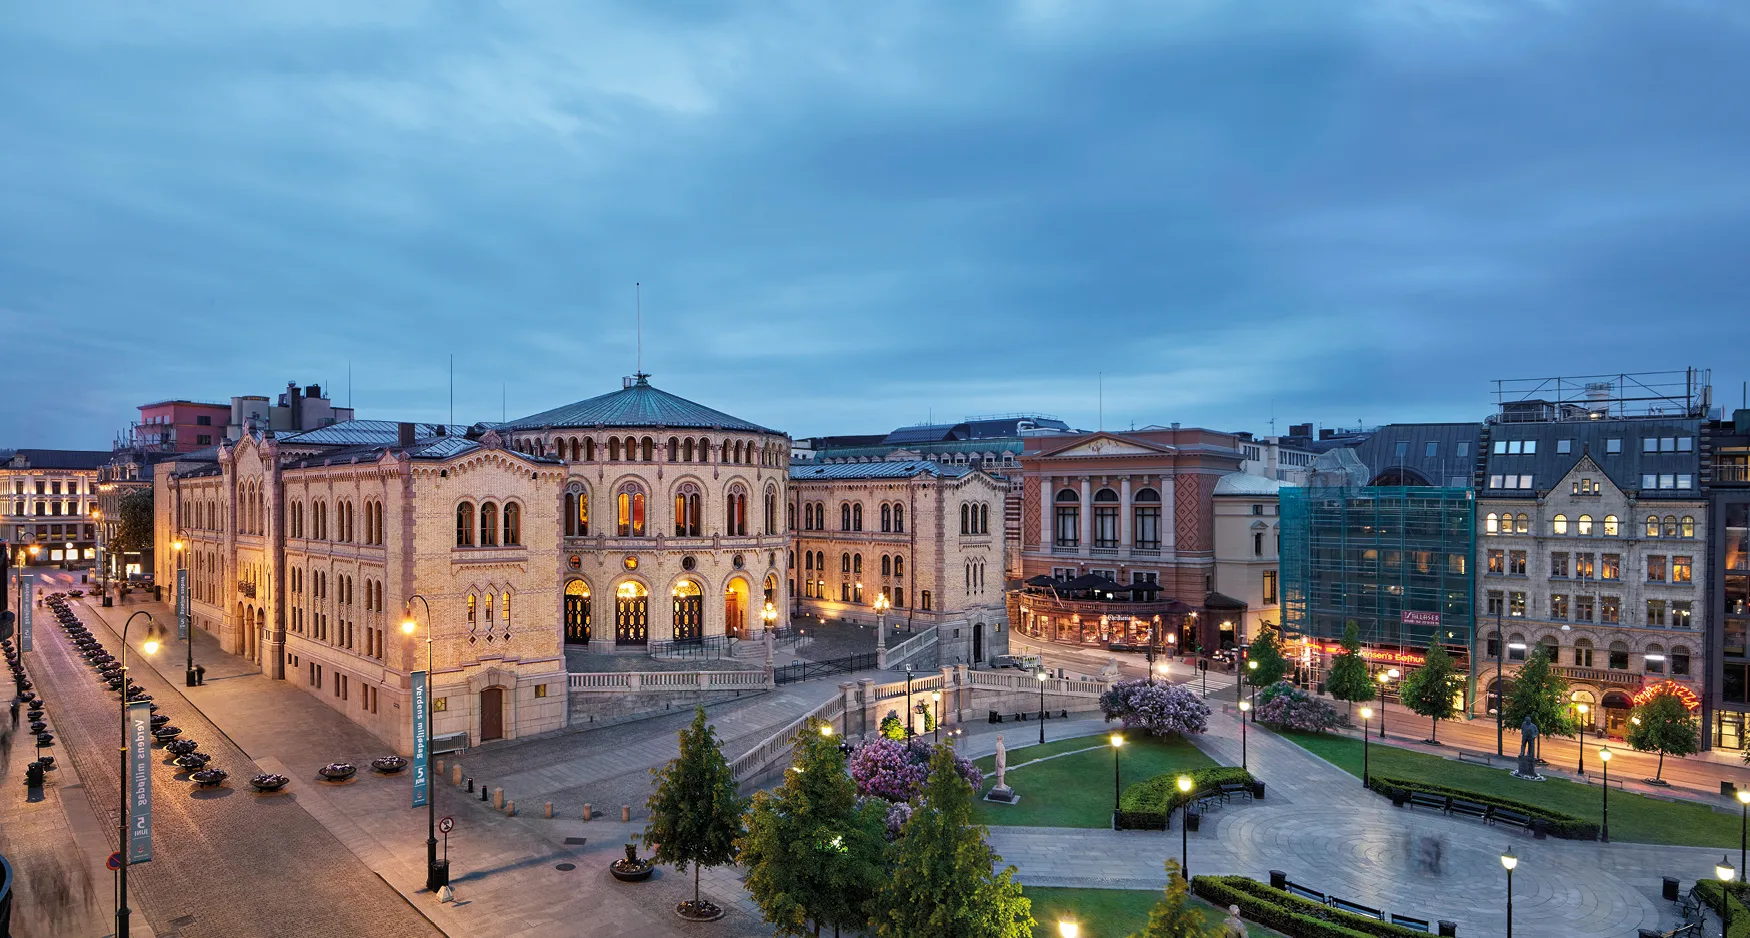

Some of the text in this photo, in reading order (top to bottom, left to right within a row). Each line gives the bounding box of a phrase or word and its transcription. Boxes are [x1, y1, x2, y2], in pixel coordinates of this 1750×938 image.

[416, 685, 425, 759] Verdens miljødag
[417, 767, 424, 779] 5
